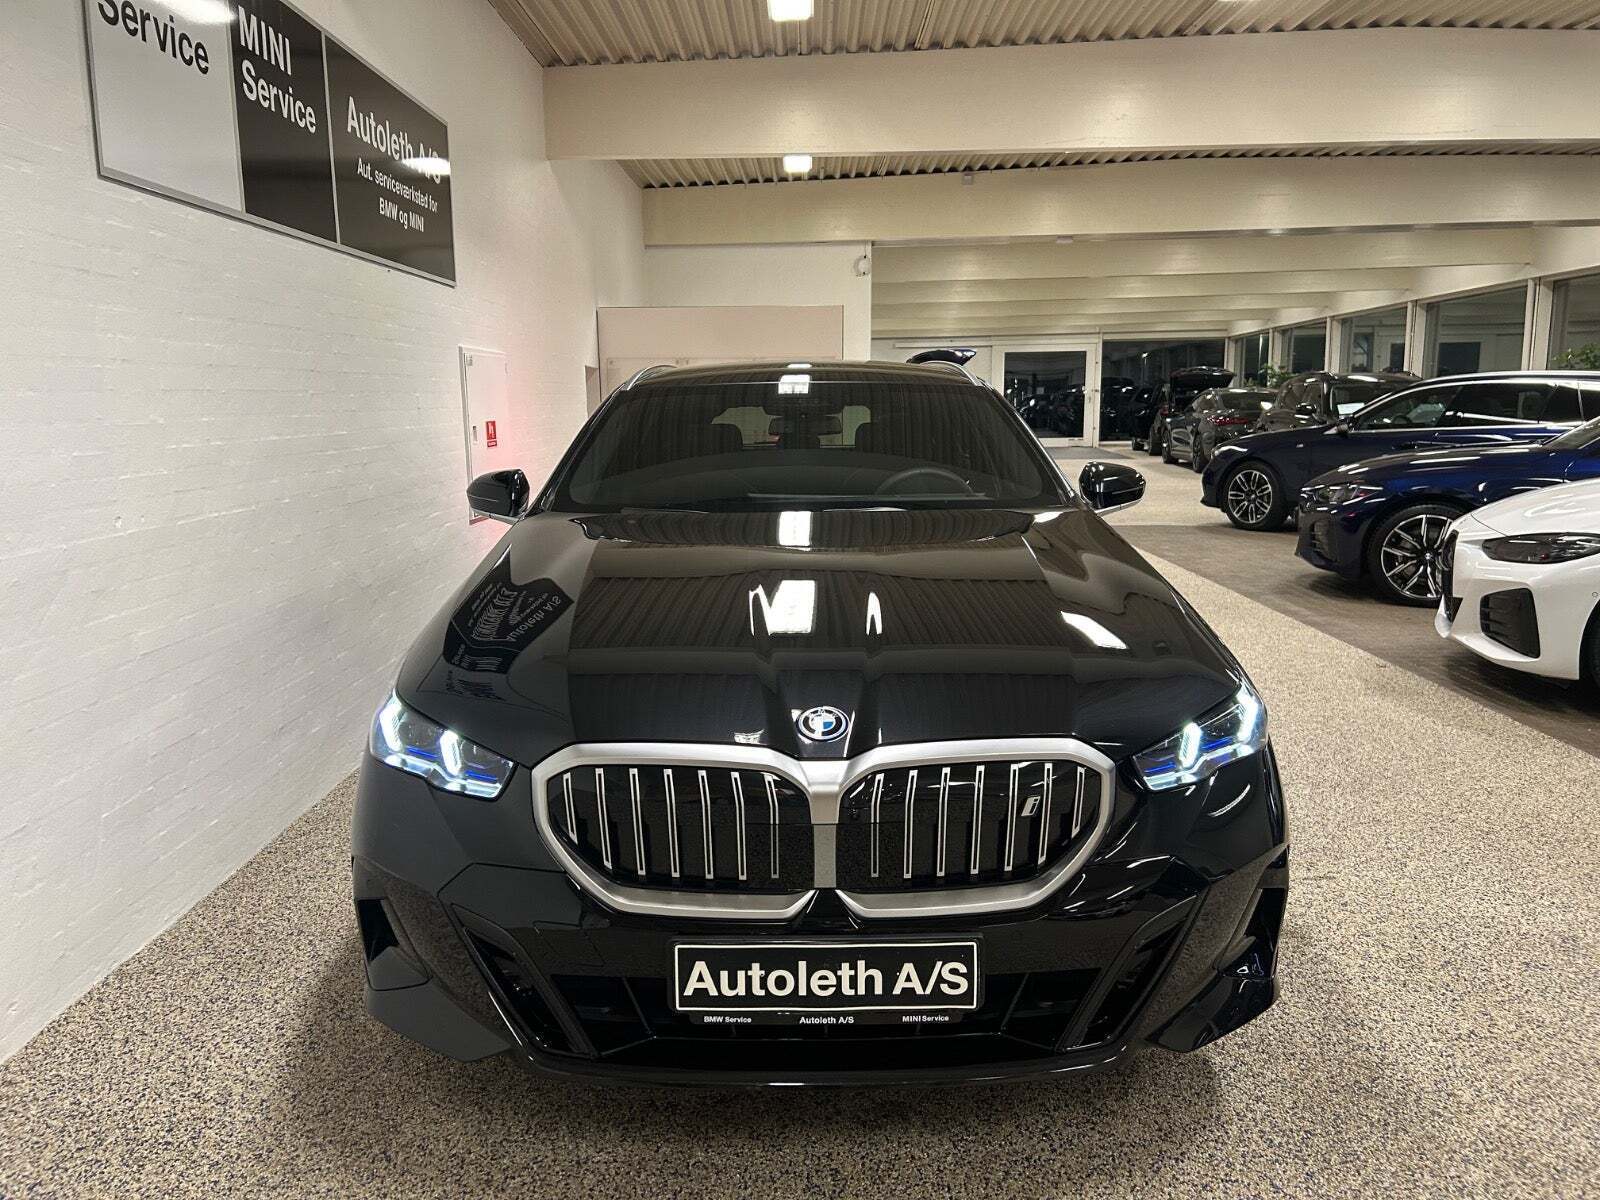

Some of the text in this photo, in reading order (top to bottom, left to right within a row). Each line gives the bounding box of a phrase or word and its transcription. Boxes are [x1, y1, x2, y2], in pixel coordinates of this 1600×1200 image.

[238, 5, 291, 76] MINI
[242, 59, 316, 134] Service
[347, 95, 415, 169] Autoleth
[357, 157, 438, 213] Aut. serviceværksted for
[380, 197, 425, 232] BMW og MINI
[683, 960, 969, 997] Autoleth A/S
[703, 1015, 723, 1023] BMW
[799, 1015, 855, 1024] Autoleth A/S
[921, 1014, 950, 1022] Service
